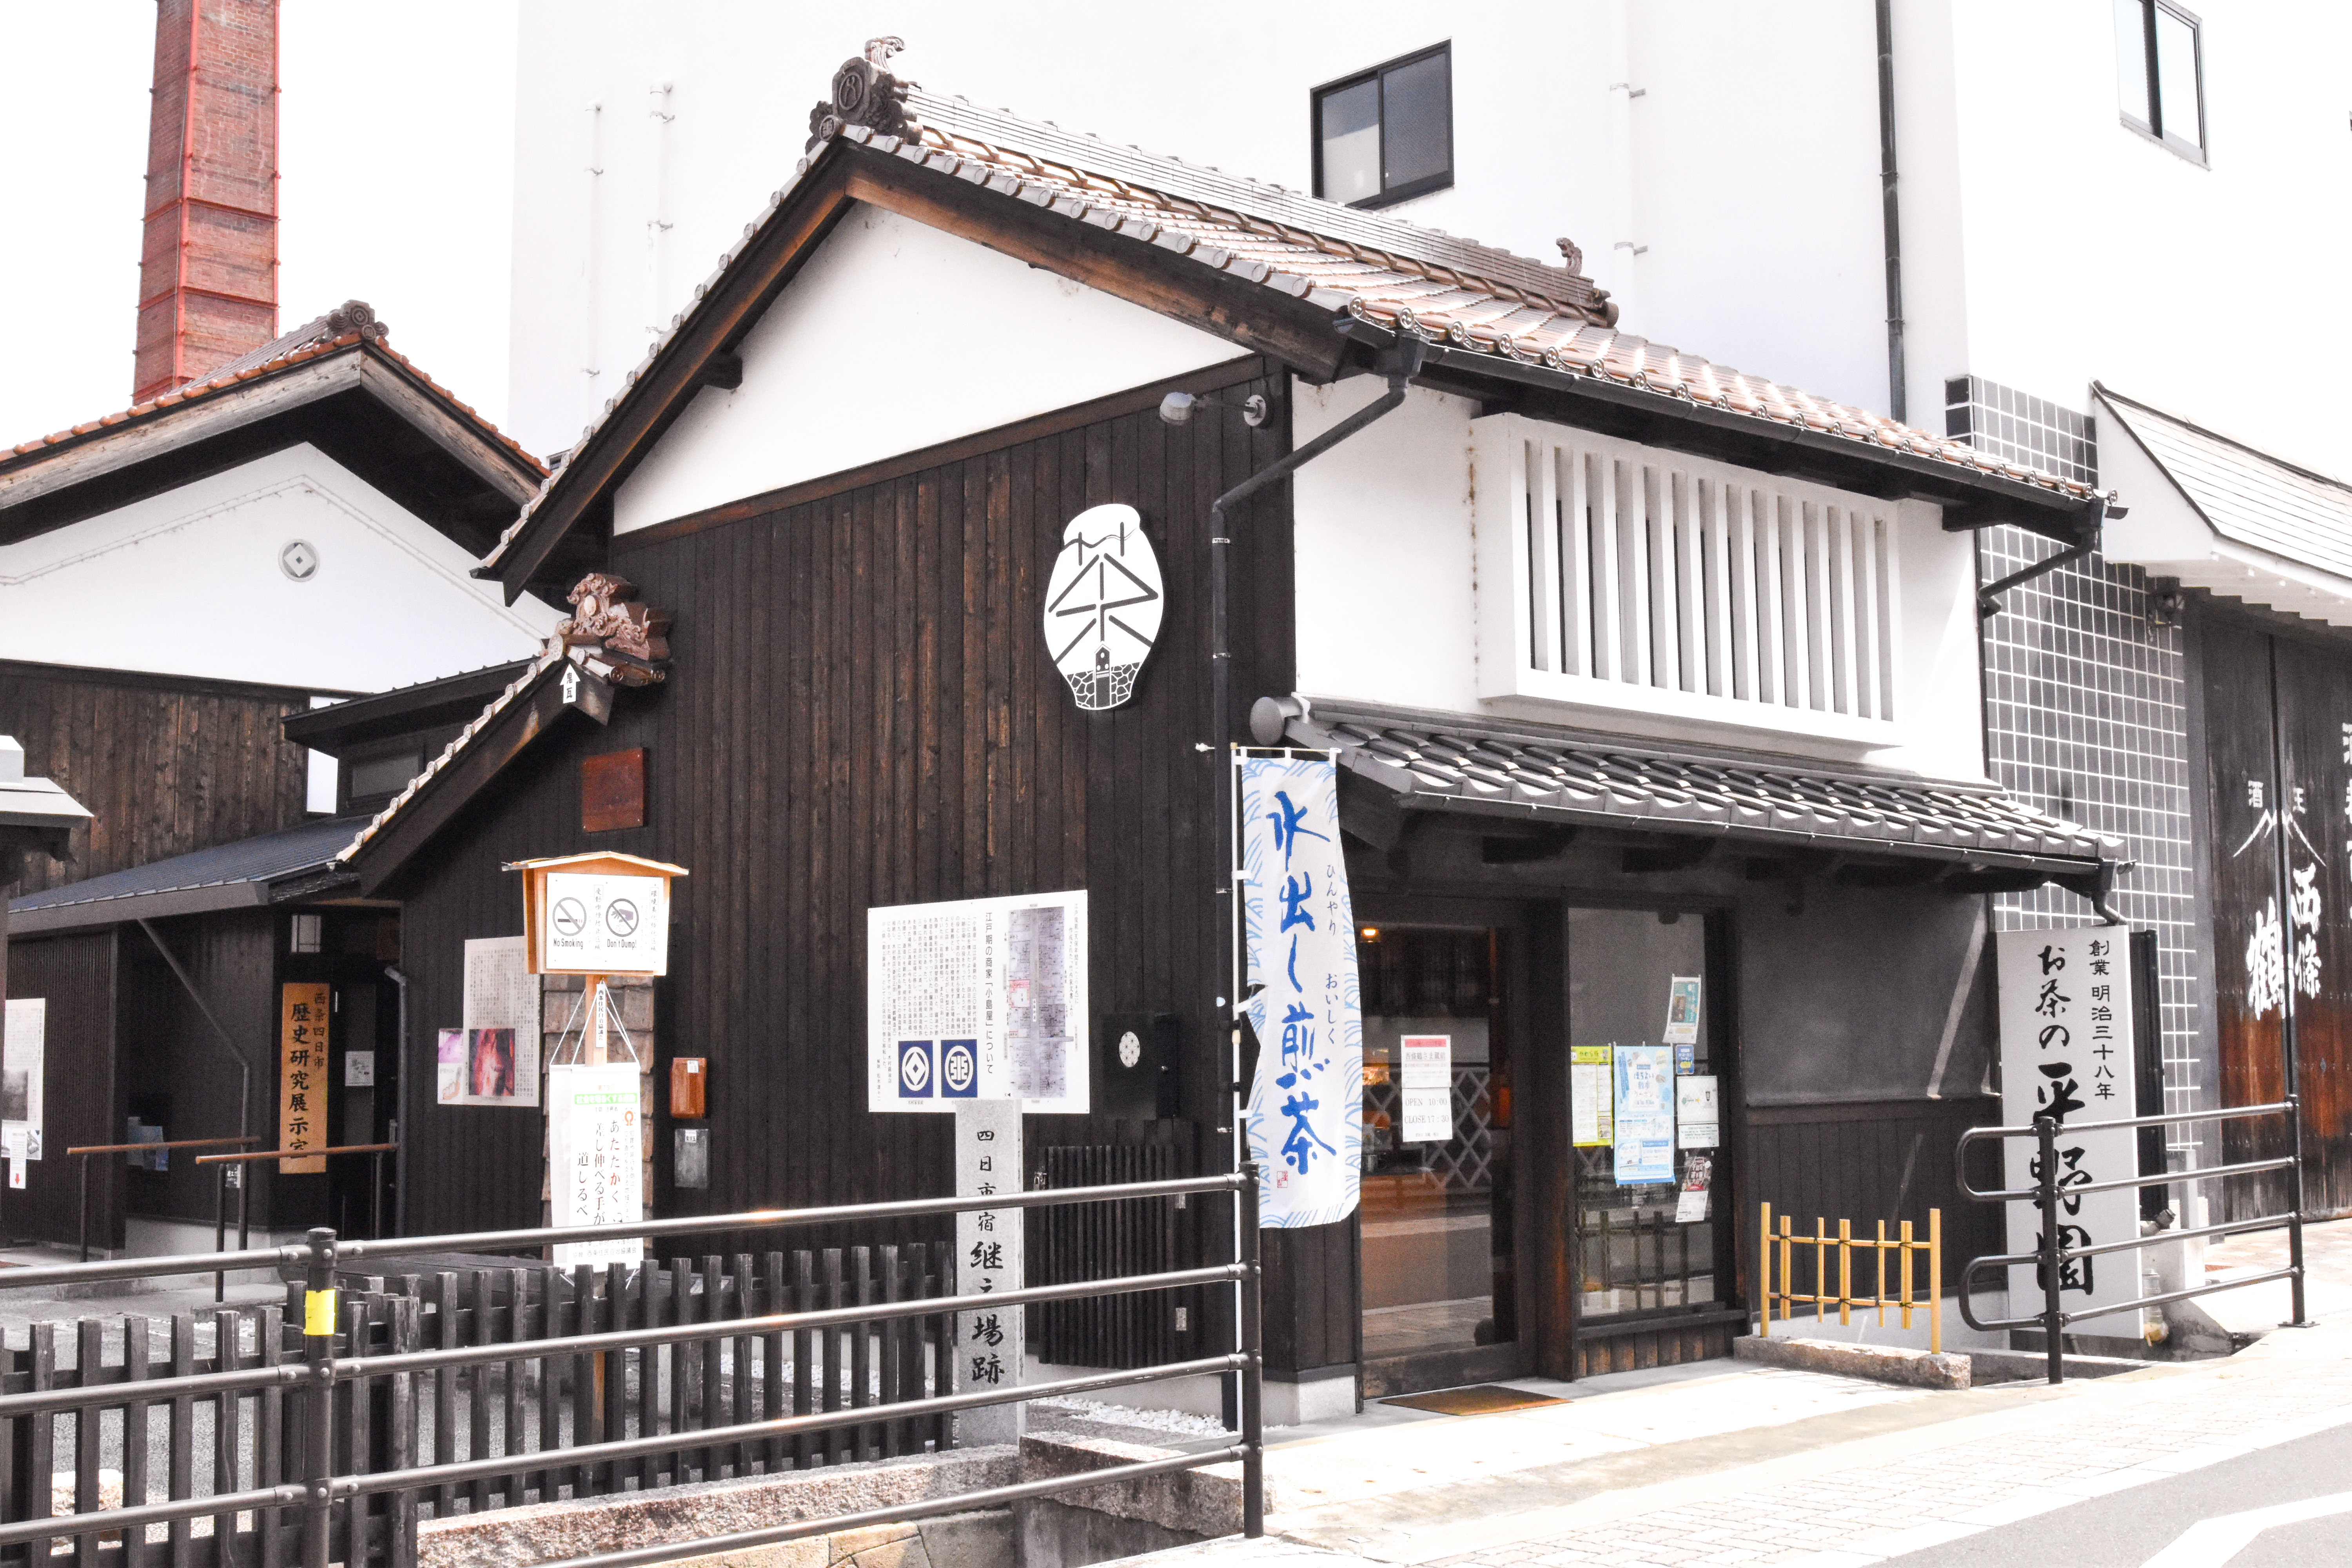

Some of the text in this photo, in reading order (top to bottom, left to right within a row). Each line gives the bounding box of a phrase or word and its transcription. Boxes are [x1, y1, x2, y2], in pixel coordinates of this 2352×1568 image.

[554, 938, 584, 950] No Smoking
[607, 939, 637, 950] Don't Dump!
[1266, 791, 1336, 1175] 水出し煎茶
[1325, 863, 1338, 1045] ひんやり おいしく
[313, 992, 325, 1071] 西条四日市
[985, 912, 994, 1074] 江戸期の商家「小島屋」について
[2089, 939, 2115, 1101] 創業 明治三十八年
[1405, 1098, 1423, 1106] OPEN
[1405, 1115, 1426, 1124] CLOSE
[576, 1152, 589, 1216] 道しるべ
[594, 1122, 605, 1225] 差し伸べる手が
